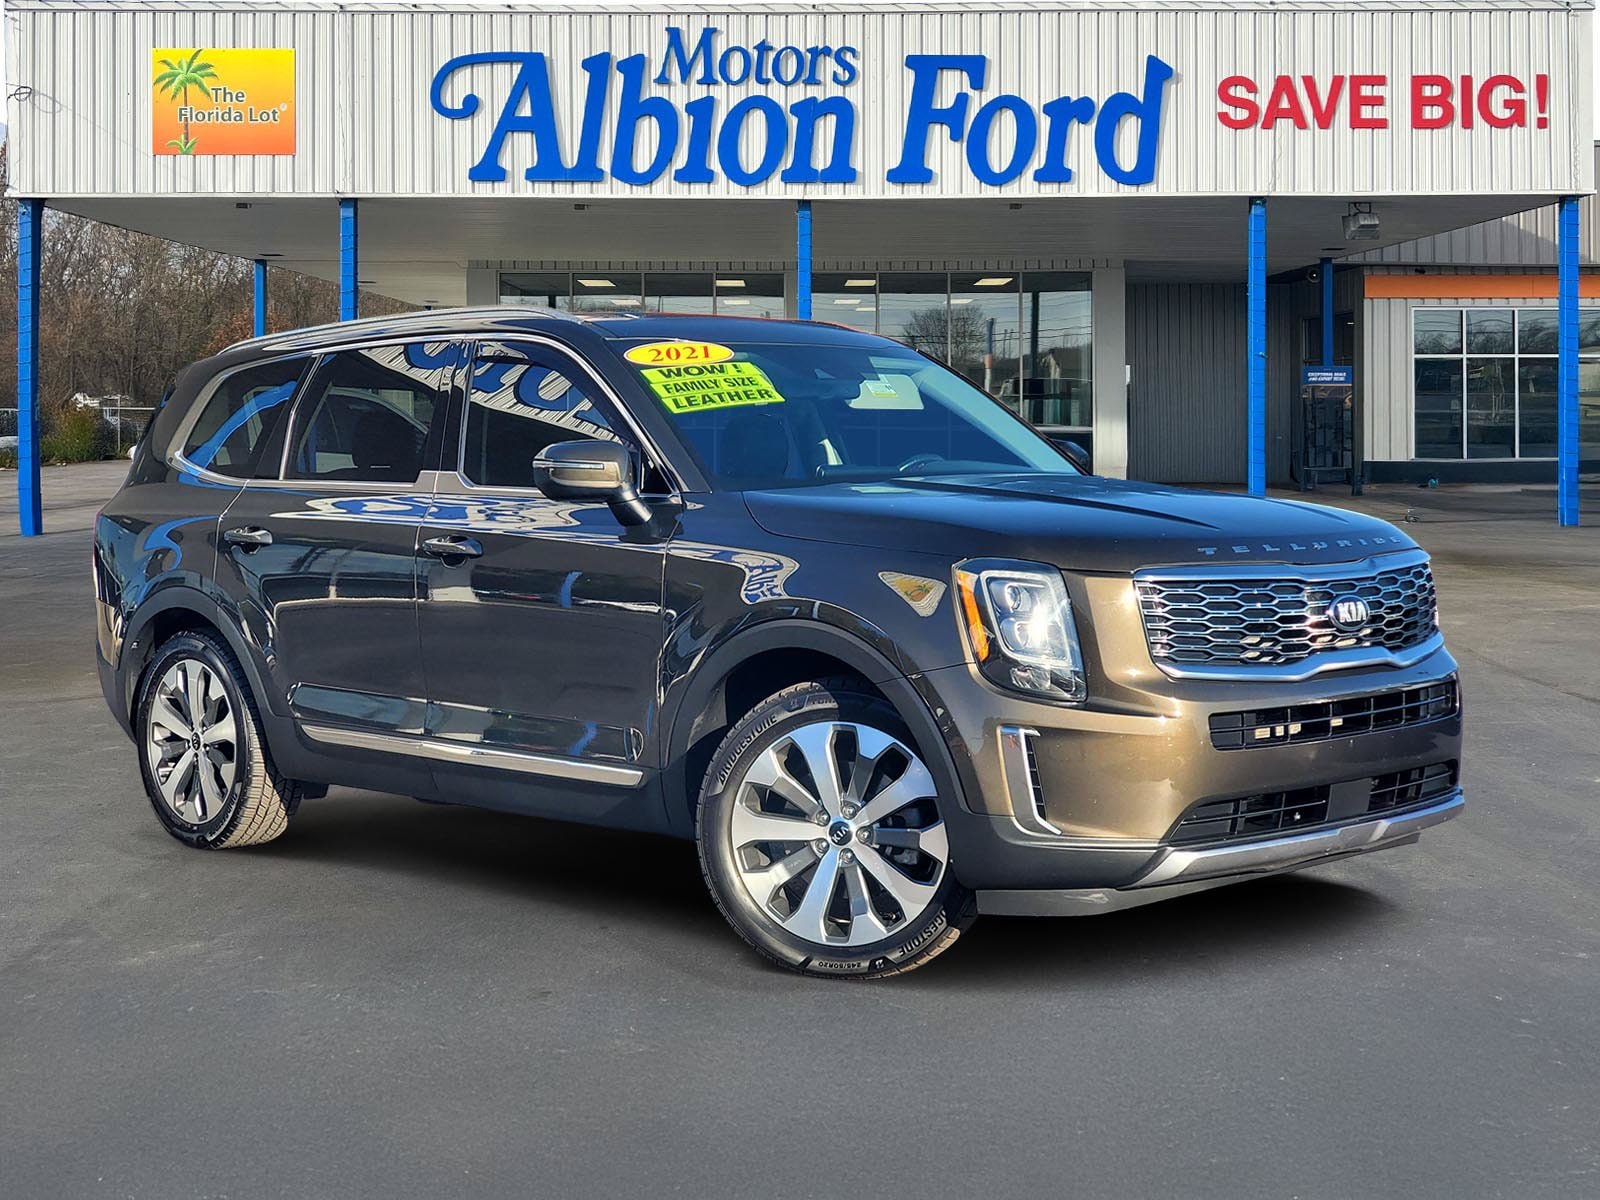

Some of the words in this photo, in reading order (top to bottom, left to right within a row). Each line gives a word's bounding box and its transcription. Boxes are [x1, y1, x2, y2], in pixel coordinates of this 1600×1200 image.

[653, 27, 858, 86] Motors
[211, 86, 246, 103] The
[1217, 75, 1388, 129] SAVE
[1410, 74, 1548, 129] BIG!
[177, 106, 244, 123] Florida
[430, 51, 857, 186] Albion
[886, 54, 1174, 186] Ford
[648, 345, 712, 363] 2021
[662, 378, 722, 394] FAMILY
[723, 376, 760, 388] SIZE
[671, 388, 774, 410] LEATHER
[1198, 536, 1402, 556] TELLURIDE
[1336, 601, 1367, 623] KIA
[831, 825, 849, 843] KIA
